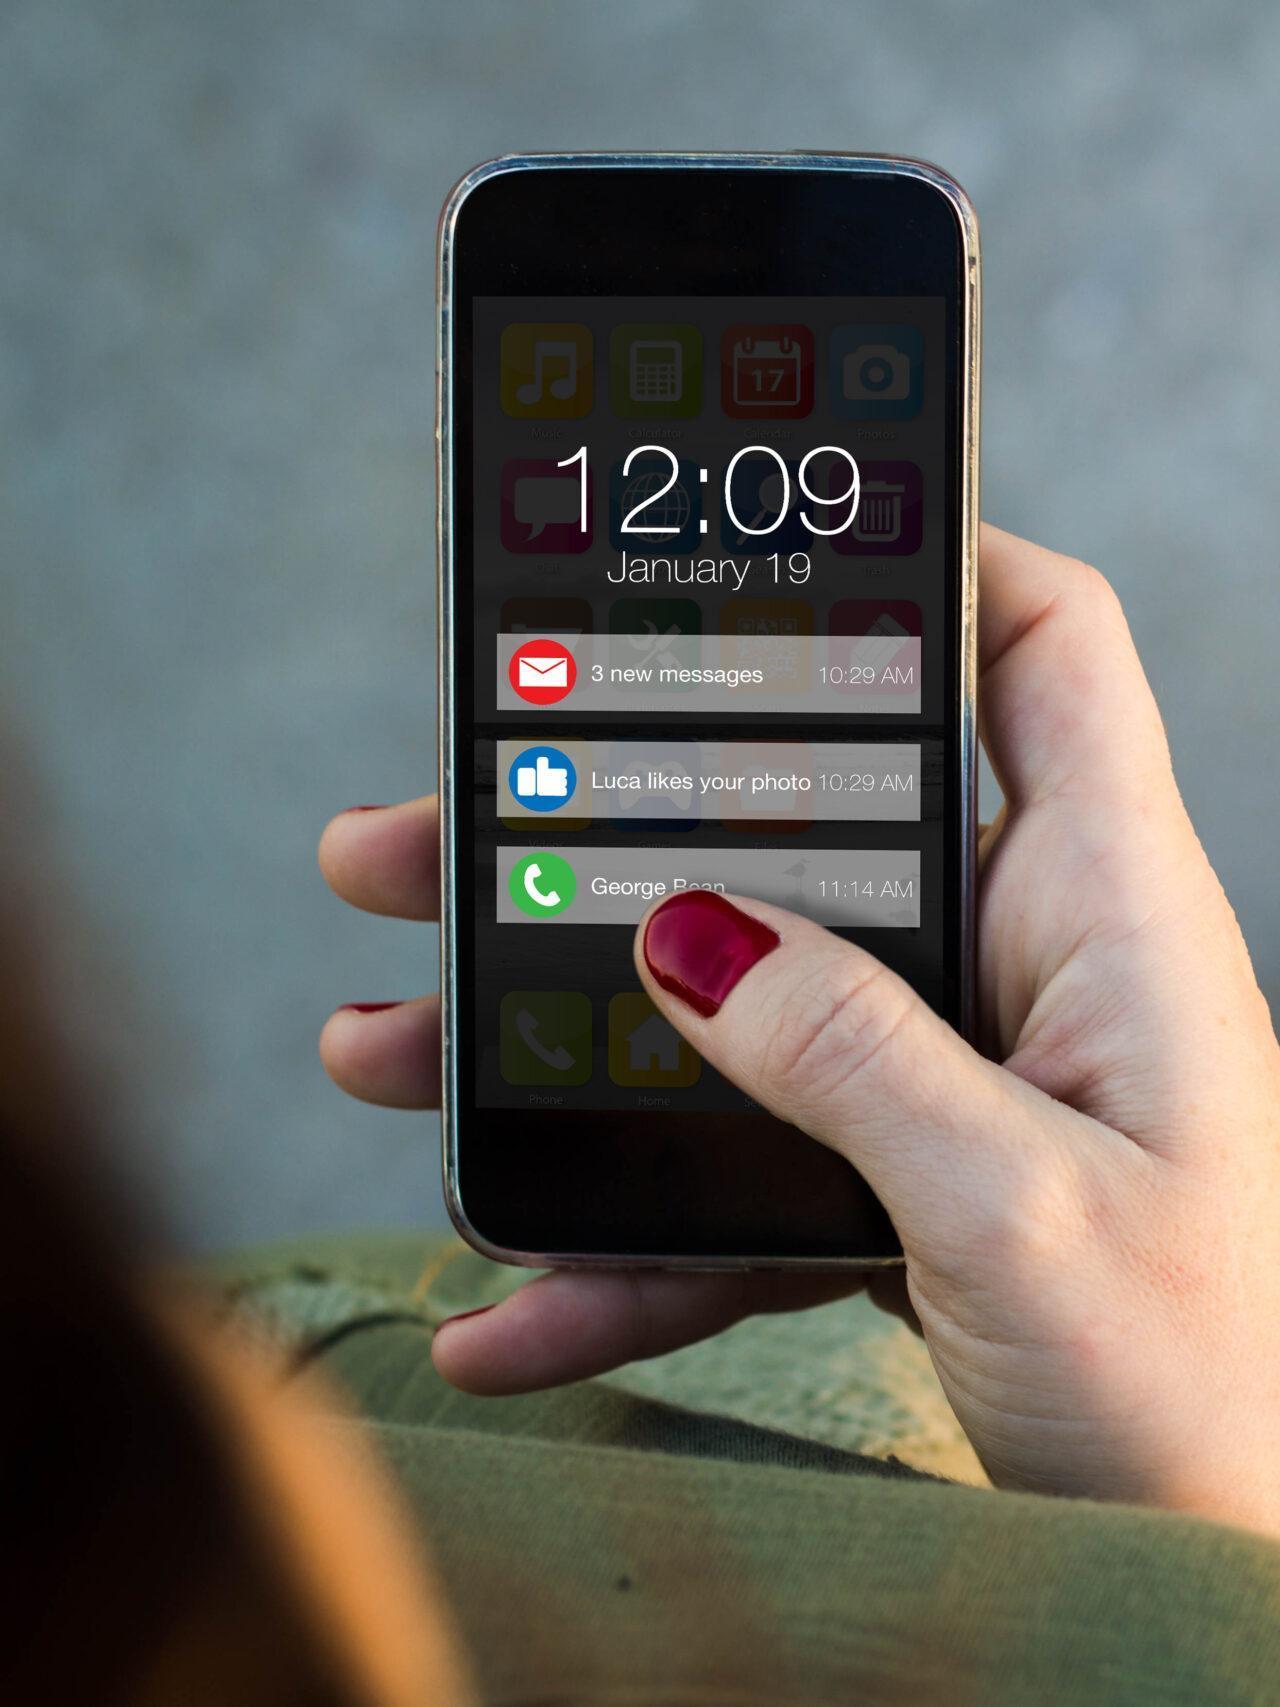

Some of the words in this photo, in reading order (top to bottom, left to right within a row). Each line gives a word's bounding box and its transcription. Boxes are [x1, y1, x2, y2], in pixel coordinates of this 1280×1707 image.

[752, 368, 785, 392] 17
[556, 444, 862, 536] 12:09
[607, 551, 751, 591] January
[766, 552, 811, 584] 19
[591, 664, 604, 683] 3
[610, 669, 653, 683] new
[659, 669, 764, 688] messages
[818, 666, 875, 684] 10:29
[880, 666, 913, 685] AM
[592, 771, 641, 790] Luca
[648, 771, 693, 790] likes
[699, 776, 746, 794] your
[752, 773, 811, 795] photo
[818, 774, 875, 792] 10:29
[880, 774, 913, 792] AM
[591, 877, 666, 899] George
[818, 880, 875, 898] 11:14
[879, 880, 913, 898] AM
[528, 1094, 564, 1106] Phone
[637, 1095, 672, 1107] Home
